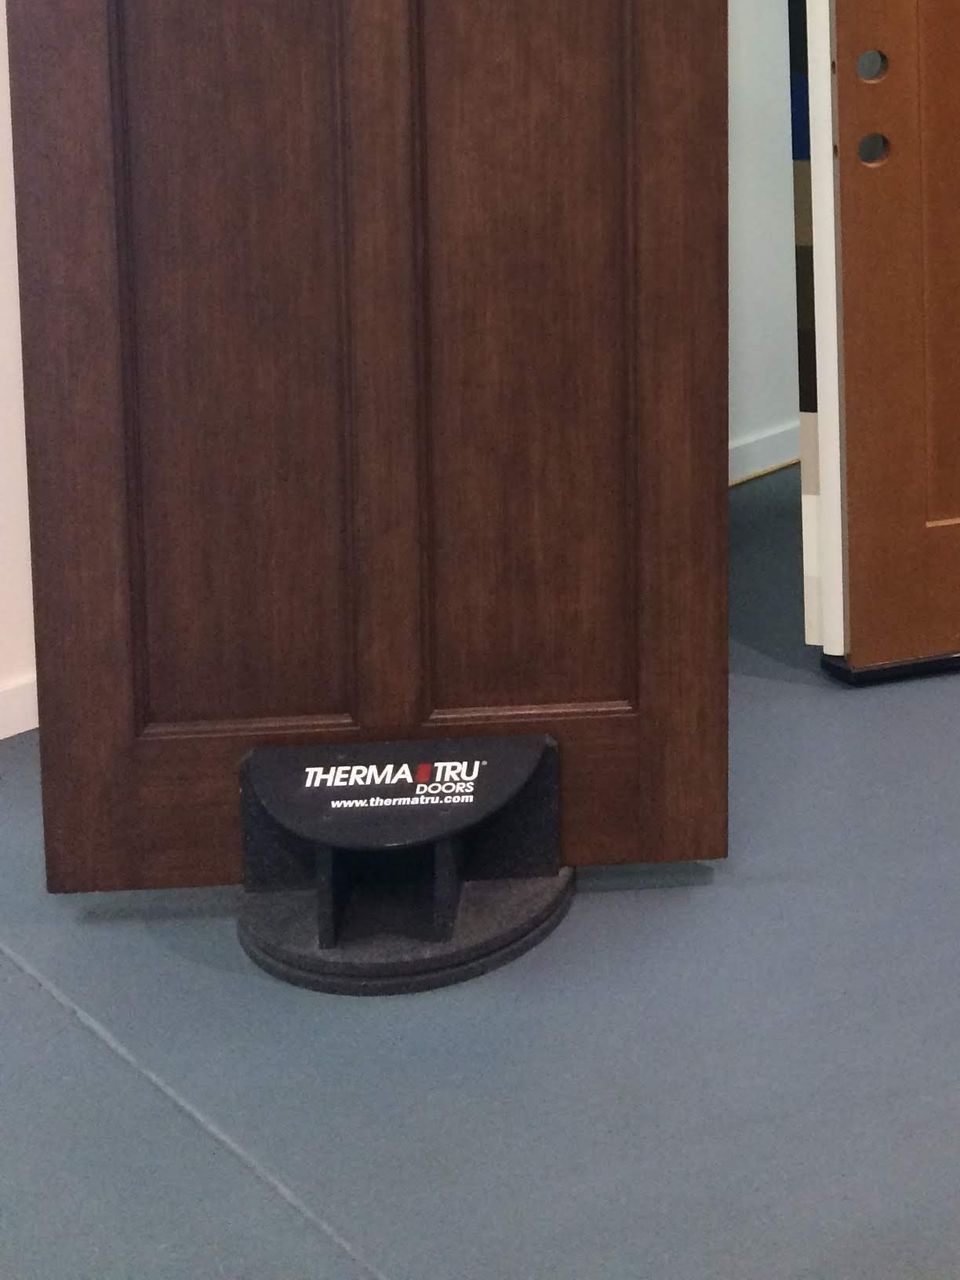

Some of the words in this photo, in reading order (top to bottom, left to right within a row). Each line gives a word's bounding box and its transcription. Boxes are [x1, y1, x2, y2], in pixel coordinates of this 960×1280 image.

[305, 763, 413, 787] THERMA
[434, 760, 480, 782] TRU
[415, 782, 474, 795] DOORS
[331, 794, 473, 808] www.thermatru.com
